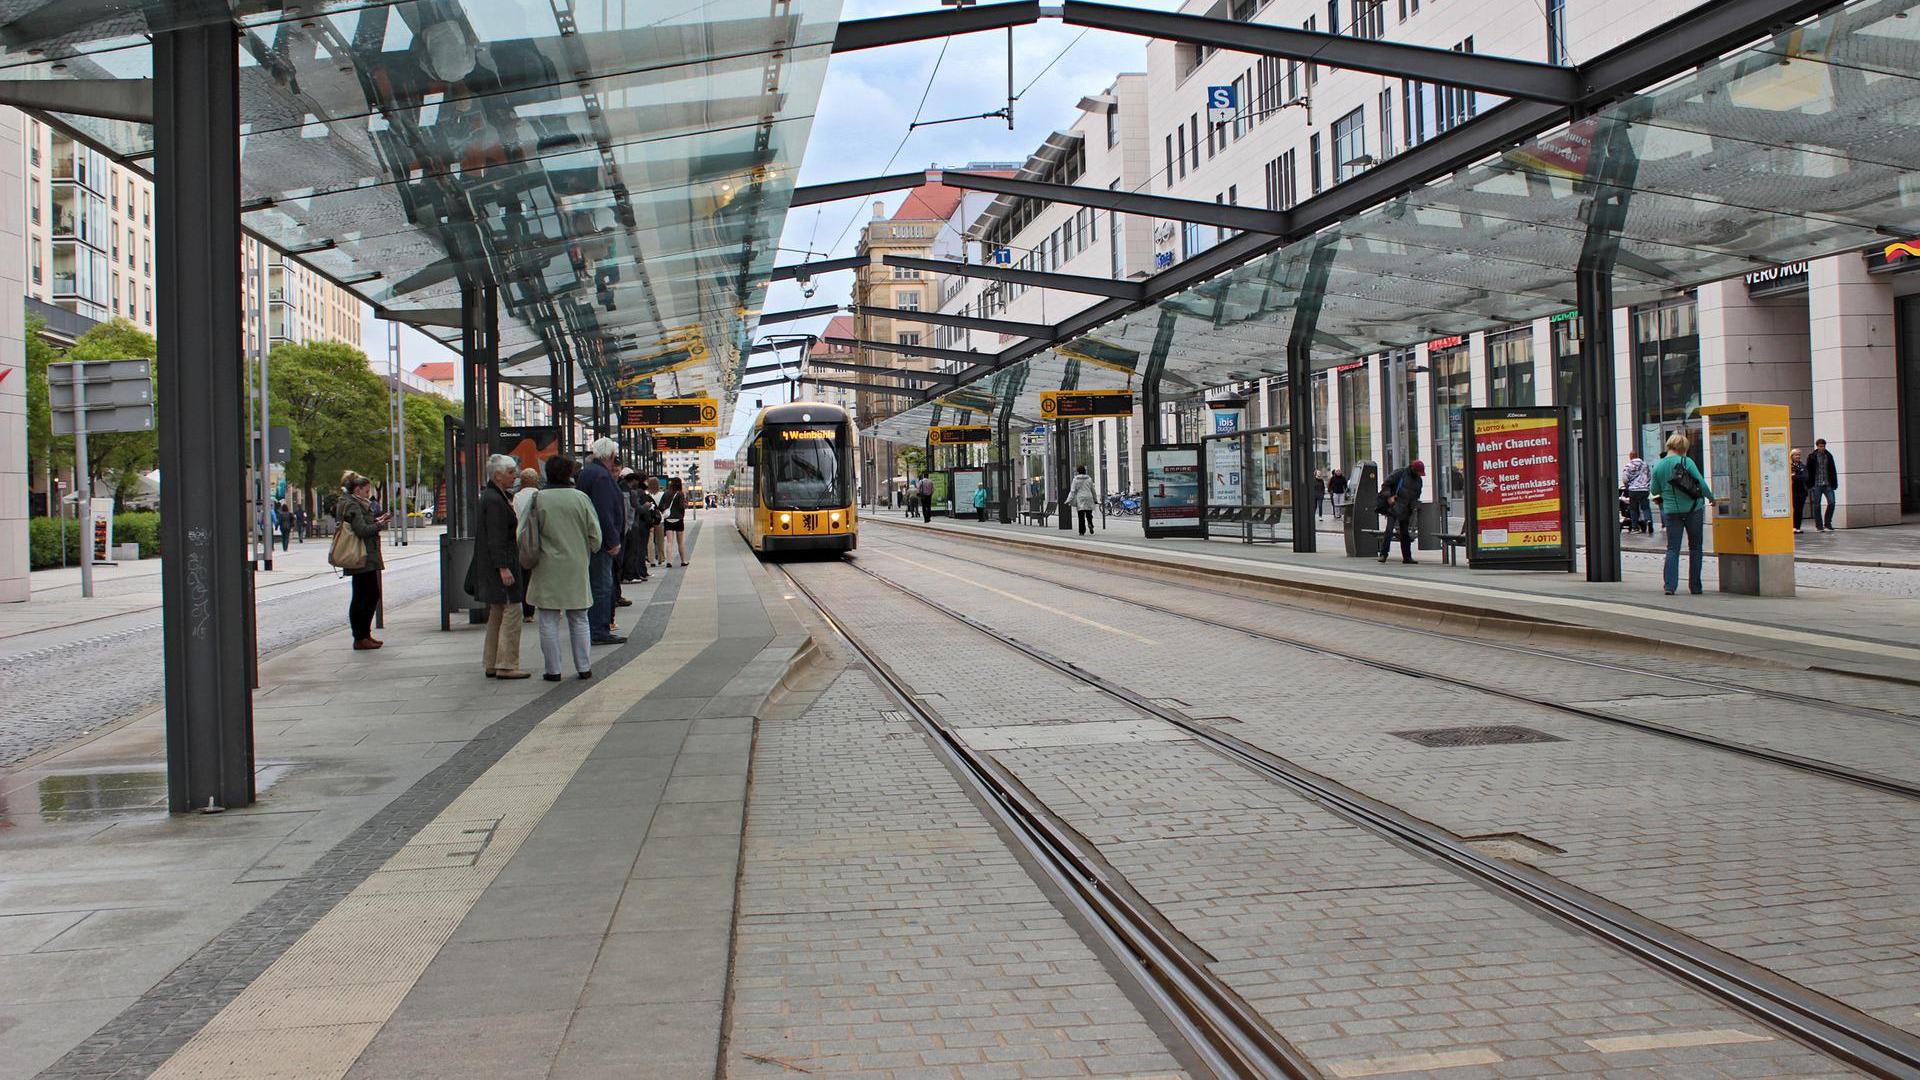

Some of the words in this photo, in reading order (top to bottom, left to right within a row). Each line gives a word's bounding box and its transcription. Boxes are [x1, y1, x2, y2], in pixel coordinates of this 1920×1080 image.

[1214, 89, 1230, 108] S
[998, 250, 1008, 262] T
[1219, 418, 1234, 427] ibis
[783, 431, 788, 440] 4
[1476, 441, 1503, 453] Mehr
[1504, 437, 1551, 450] Chancen.
[1483, 458, 1509, 470] Mehr
[1510, 455, 1557, 467] Gewinne.
[1498, 474, 1520, 482] Neue
[1500, 479, 1559, 491] Gewinnklasse.
